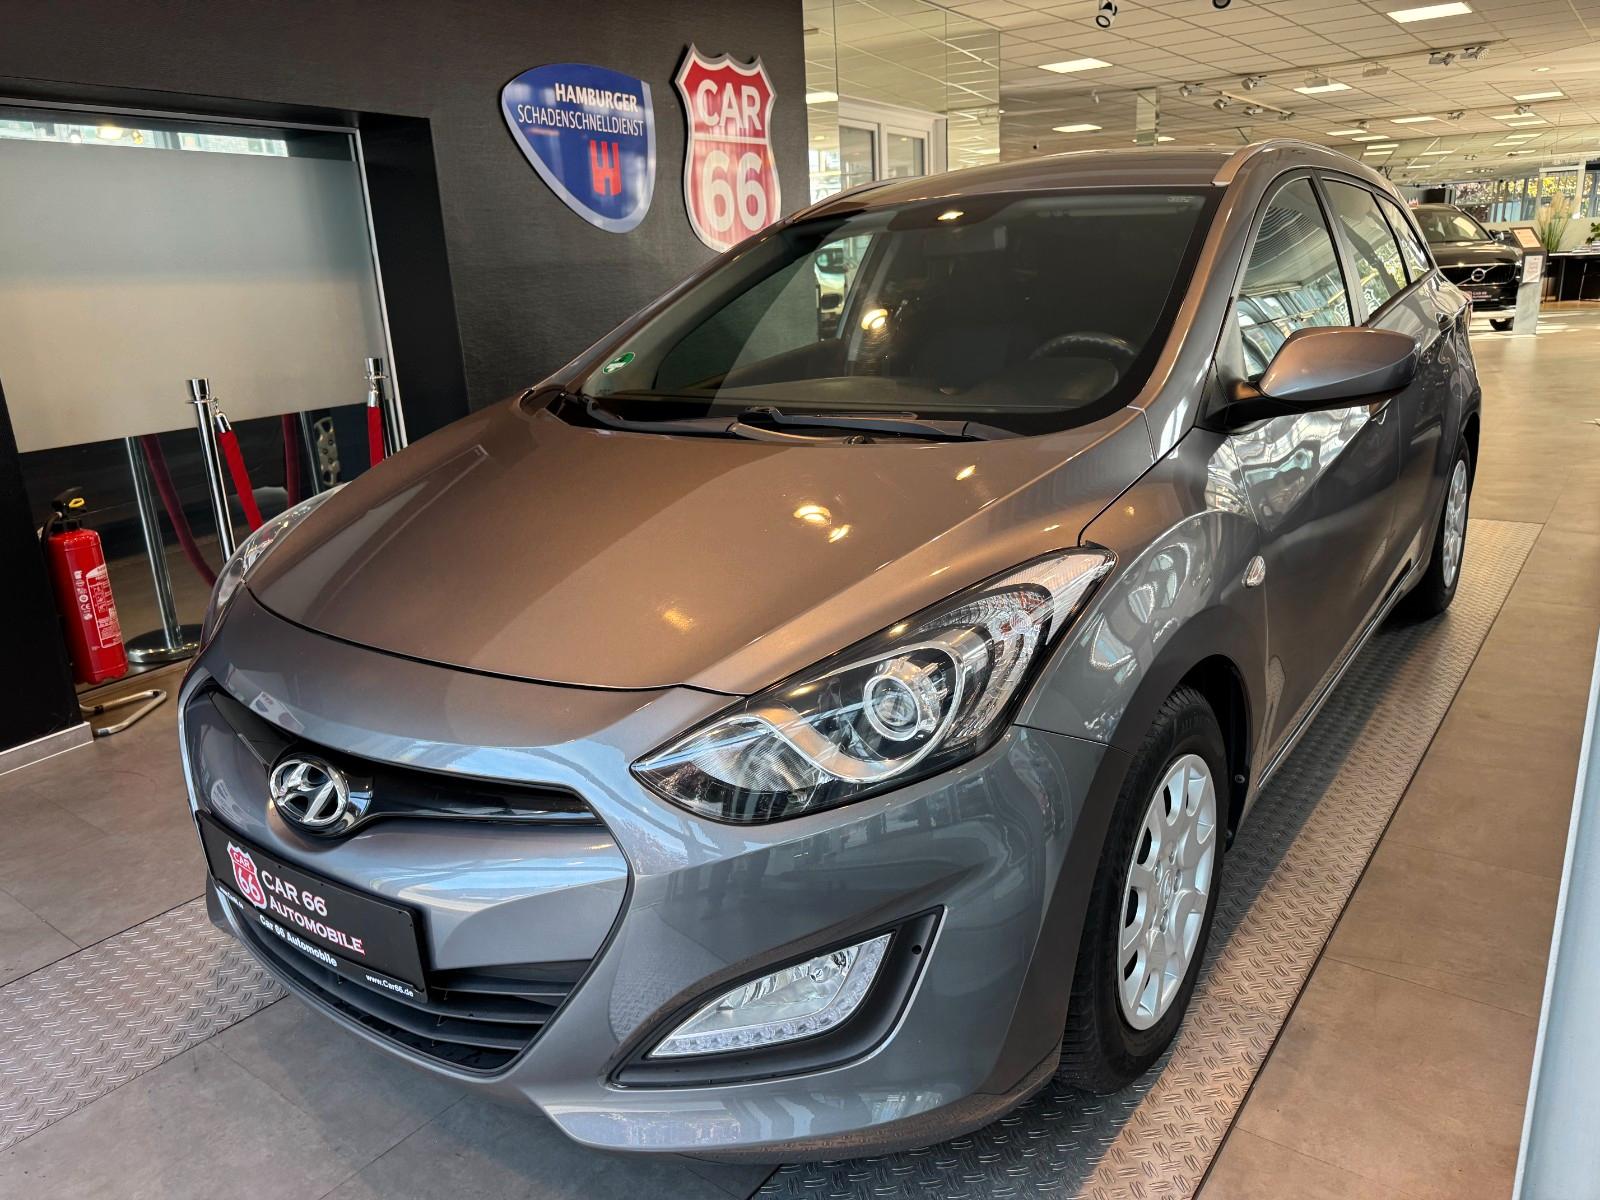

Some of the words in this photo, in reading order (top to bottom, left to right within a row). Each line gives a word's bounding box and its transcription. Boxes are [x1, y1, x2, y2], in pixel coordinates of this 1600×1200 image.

[517, 104, 644, 137] SCHADENSCHNELLDIENST
[555, 82, 638, 113] HAMBURGER
[696, 79, 762, 131] CAR
[702, 149, 767, 232] 66
[261, 870, 302, 905] CAR
[302, 890, 328, 917] 66
[269, 894, 366, 955] AUTOMOBILE
[286, 931, 338, 967] Automobile
